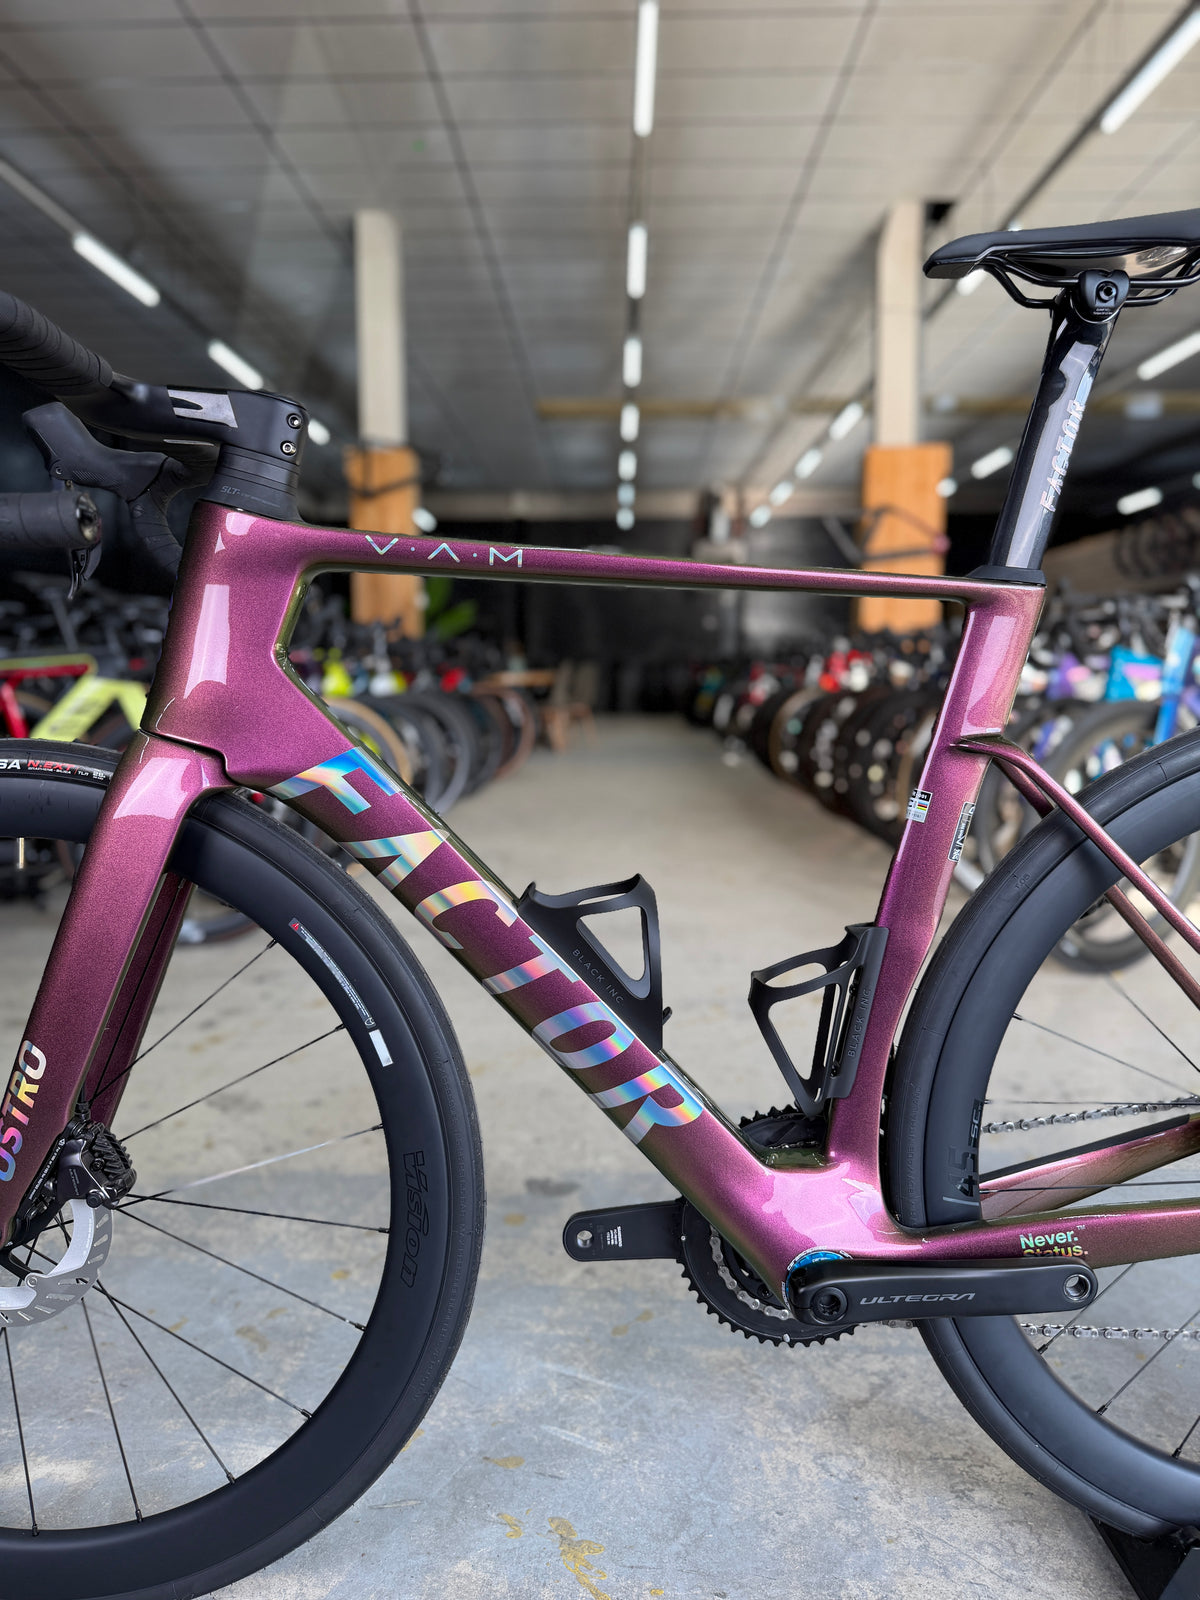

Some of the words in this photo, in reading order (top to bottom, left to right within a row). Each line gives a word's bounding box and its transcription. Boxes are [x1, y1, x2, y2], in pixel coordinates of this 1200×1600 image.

[1040, 399, 1086, 513] FACTOR
[267, 746, 703, 1145] FACTOR
[572, 949, 605, 982] BLACK
[606, 984, 624, 1004] INC
[848, 1016, 865, 1057] BLACK
[861, 988, 871, 1011] INC
[401, 1150, 430, 1289] Vision
[1019, 1230, 1079, 1249] Never.
[860, 1292, 976, 1305] ULTEGRA
